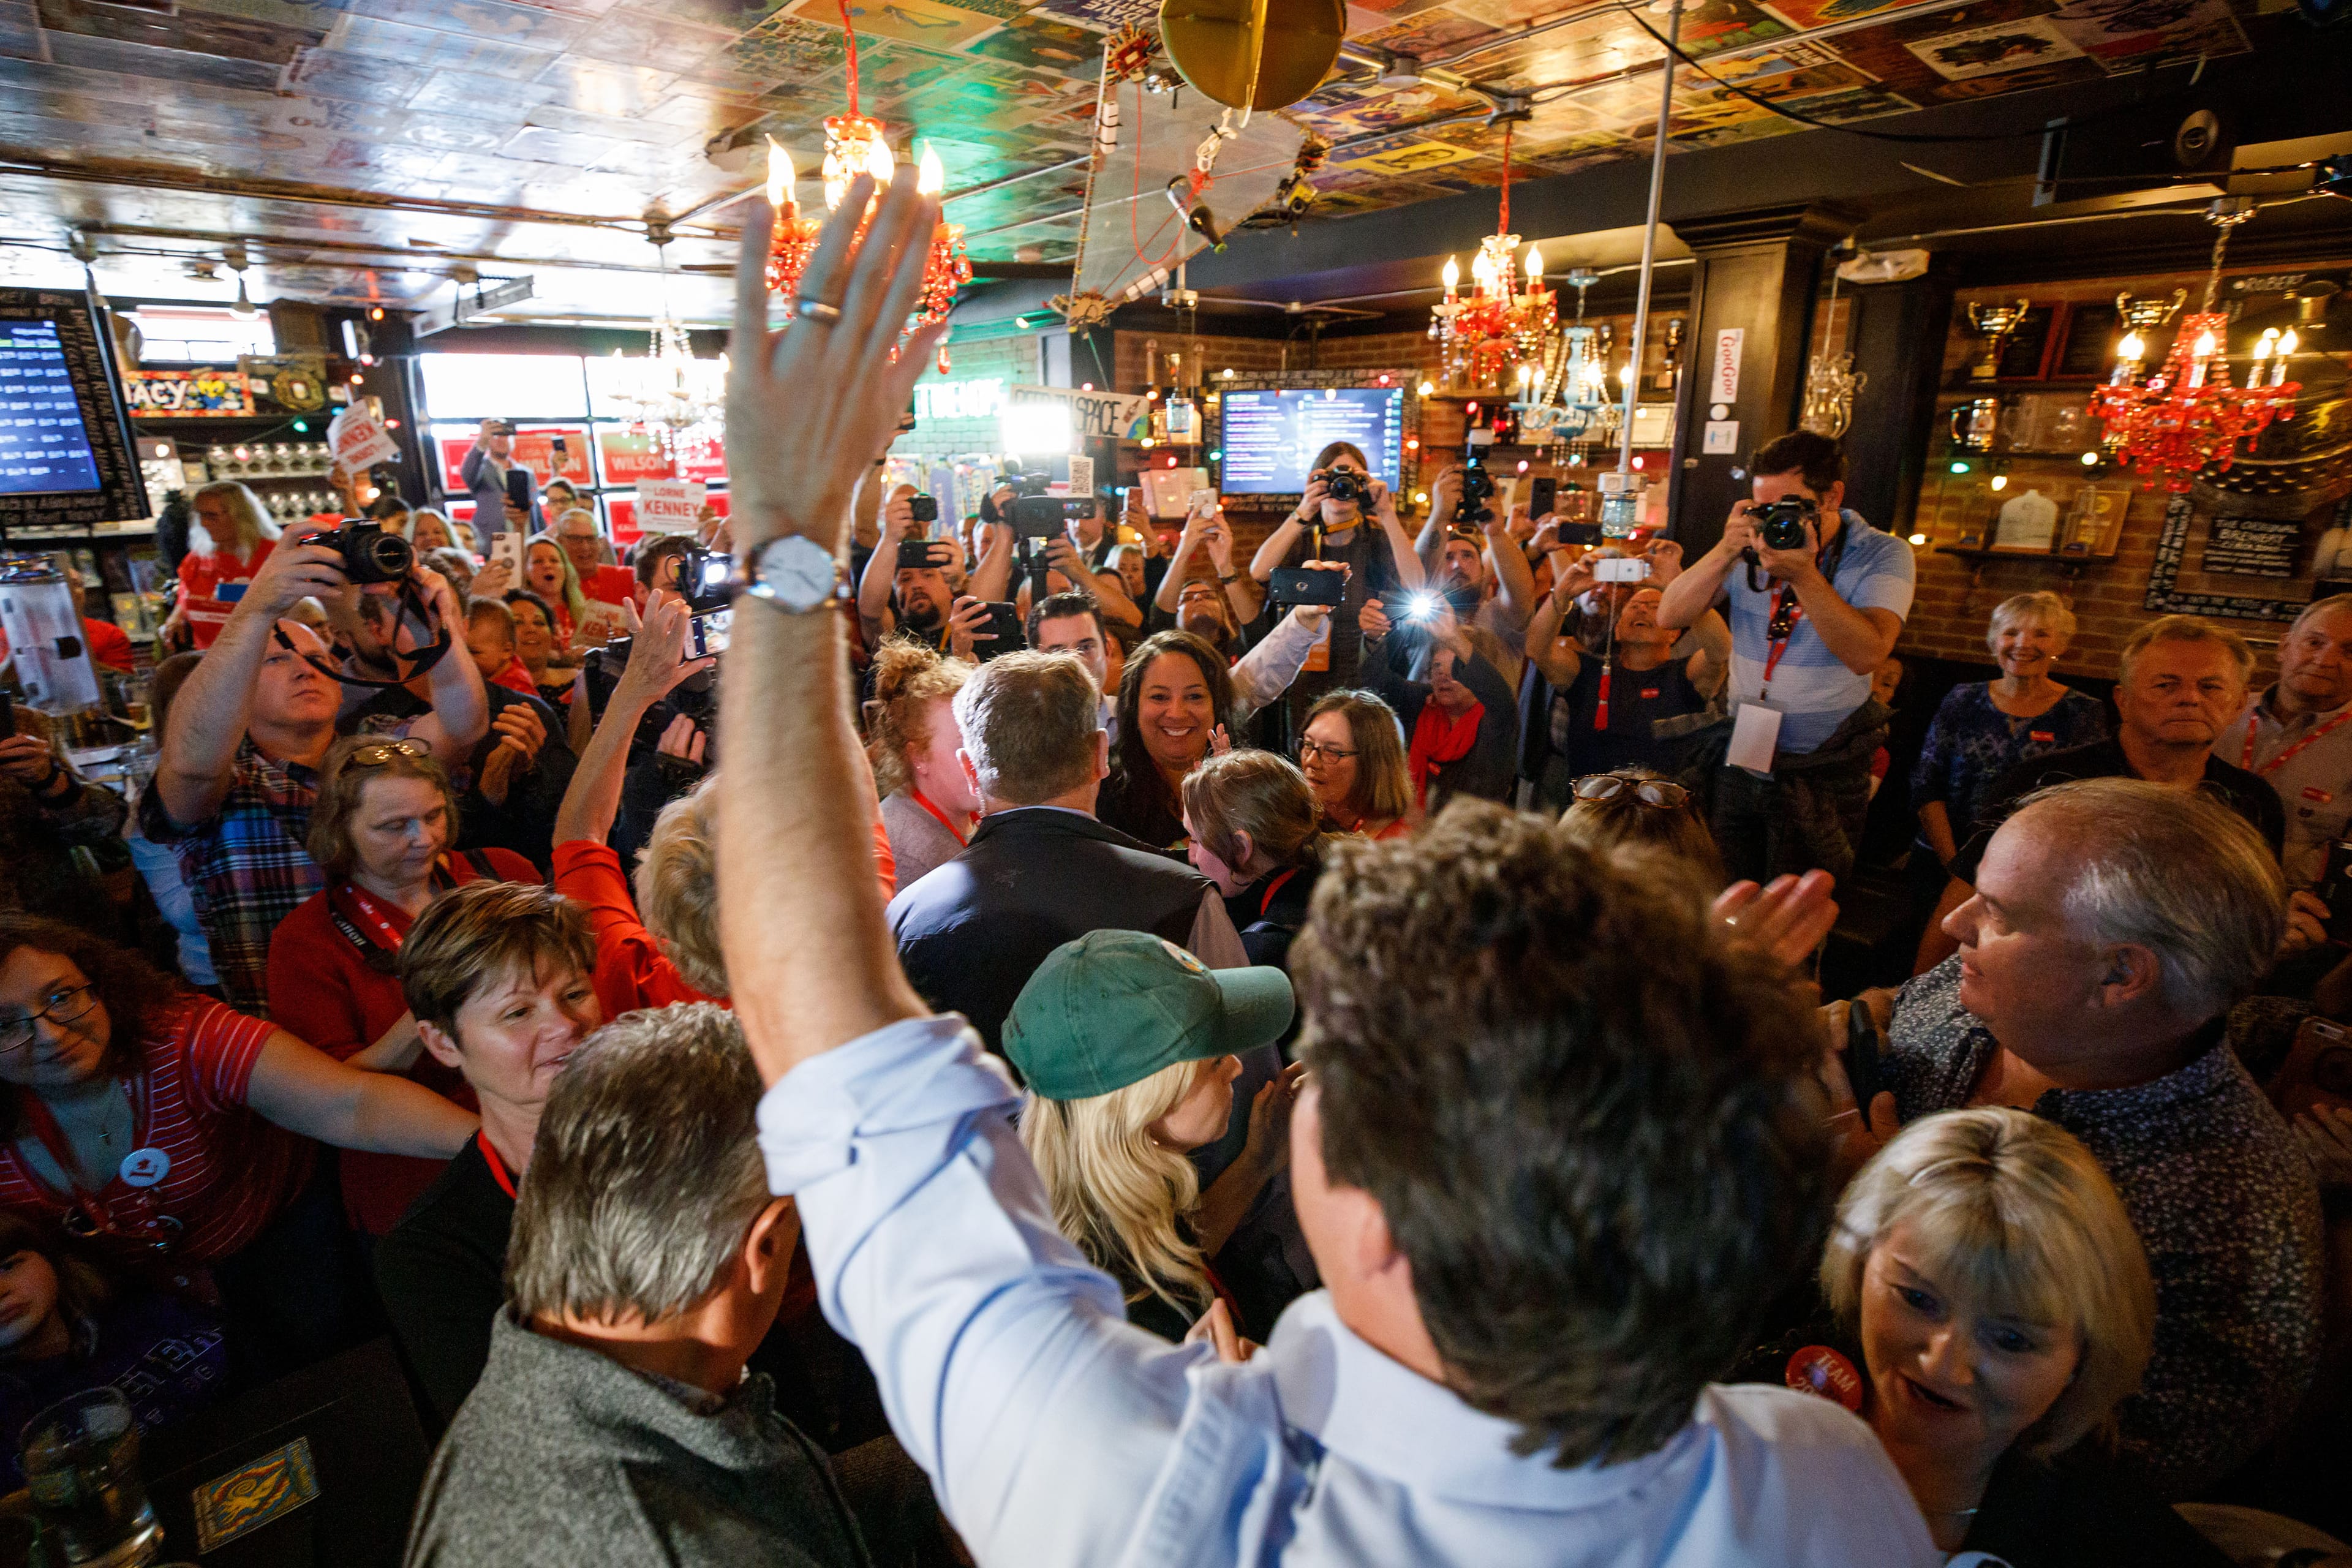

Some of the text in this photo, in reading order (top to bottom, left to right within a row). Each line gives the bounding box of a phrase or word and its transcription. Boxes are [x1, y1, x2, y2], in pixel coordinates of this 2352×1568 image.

[1080, 1, 1142, 21] DAVE
[1075, 396, 1122, 437] SPACE
[611, 456, 669, 471] WILSON
[654, 486, 687, 498] LORNE
[644, 499, 702, 517] KENNEY
[1816, 1352, 1856, 1392] TEAM
